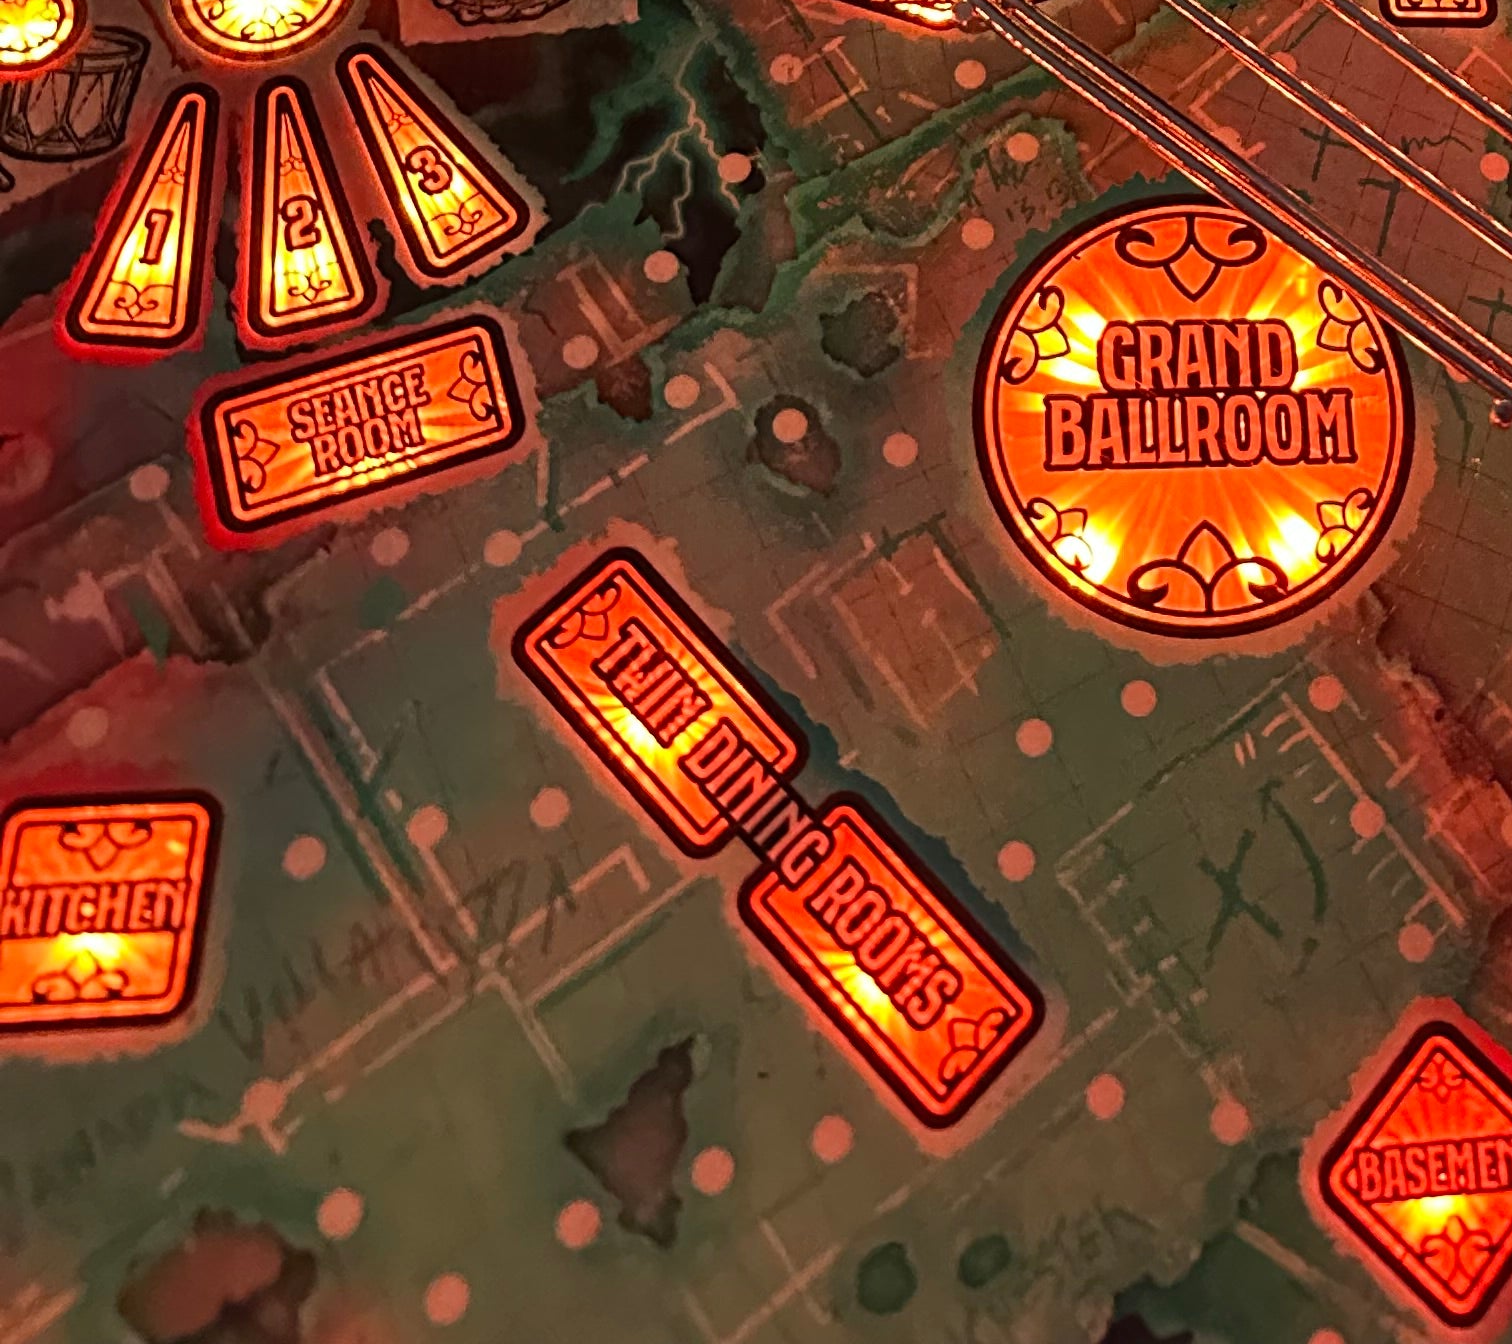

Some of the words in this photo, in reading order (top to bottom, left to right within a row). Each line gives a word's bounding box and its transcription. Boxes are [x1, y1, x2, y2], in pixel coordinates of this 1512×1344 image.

[406, 145, 452, 194] 3
[140, 209, 172, 263] 1
[284, 199, 320, 250] 2
[1101, 321, 1295, 390] GRAND
[290, 365, 430, 441] SEANCE
[1048, 391, 1356, 467] BALLROOM
[312, 408, 424, 475] ROOM
[599, 622, 710, 742] TWIN
[685, 719, 833, 888] DINING
[811, 864, 958, 1025] ROOMS
[0, 878, 187, 937] KITCHEN
